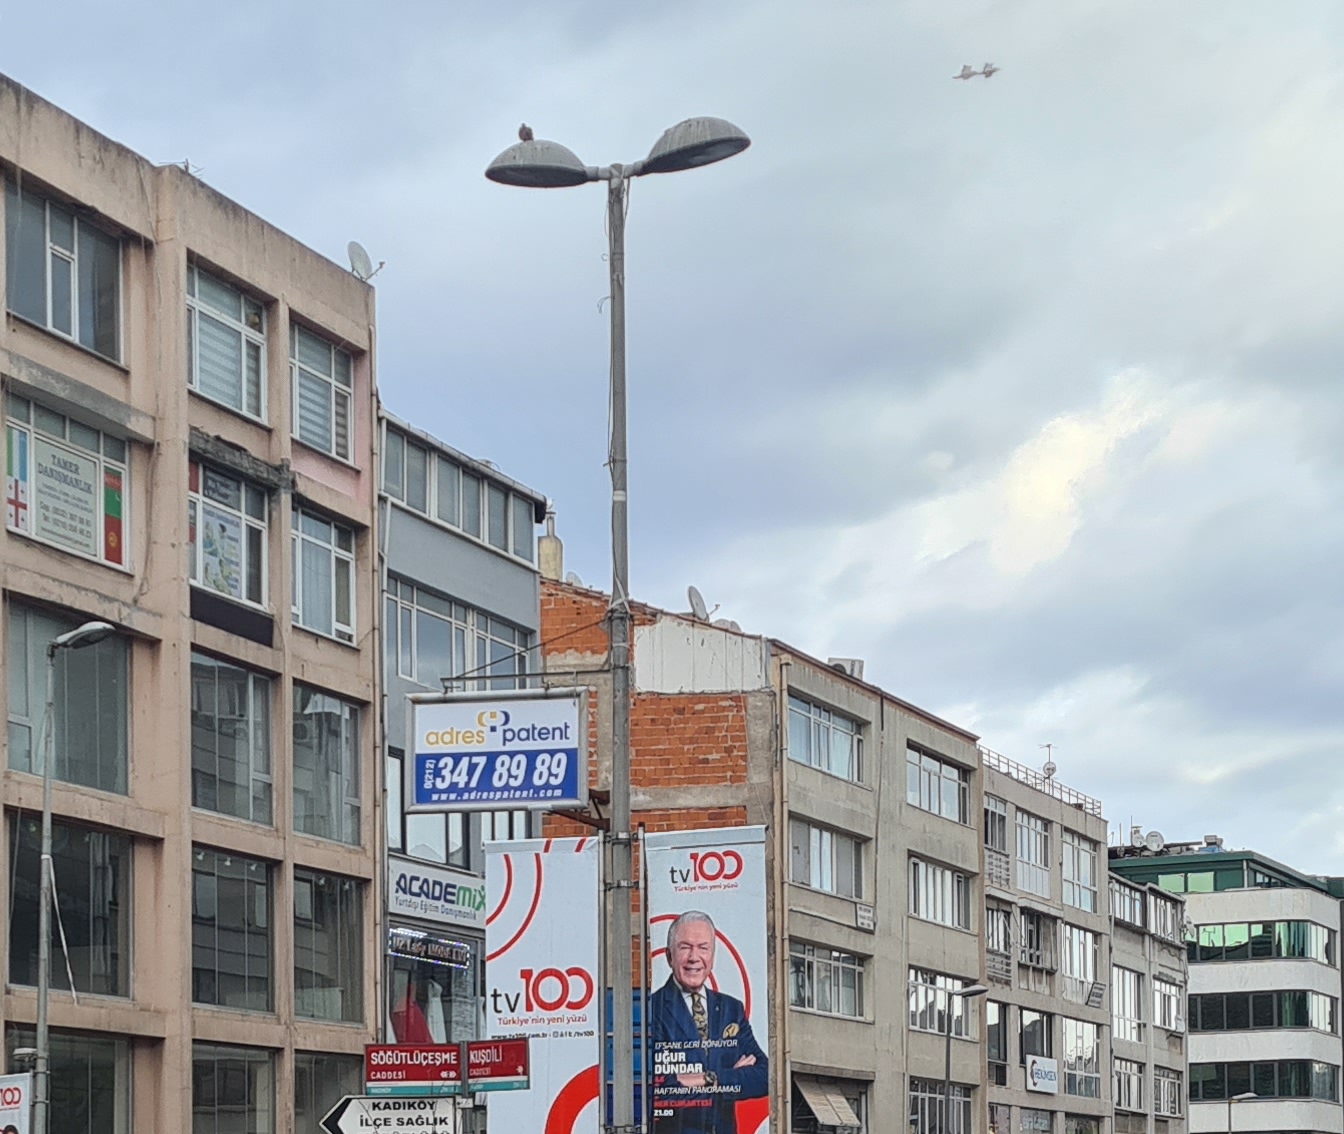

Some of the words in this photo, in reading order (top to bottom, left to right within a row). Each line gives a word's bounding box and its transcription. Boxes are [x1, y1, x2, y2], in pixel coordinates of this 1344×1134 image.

[426, 727, 485, 745] adres
[502, 722, 570, 746] patent
[435, 756, 487, 790] 347
[492, 754, 527, 787] 89
[532, 752, 568, 786] 89
[431, 788, 562, 801] www.adrespatent.com
[670, 850, 744, 884] tv100
[490, 967, 594, 1013] tv100
[546, 1016, 565, 1025] yeni
[370, 1050, 457, 1066] SÖĞÜTLÜÇEŞME
[654, 1050, 686, 1063] UĞUR
[370, 1070, 406, 1080] CADDESİ
[654, 1062, 703, 1075] DÜNDAR
[372, 1100, 436, 1111] KADIKÖY
[360, 1114, 391, 1128] İLÇE
[396, 1113, 449, 1126] SAĞLIK
